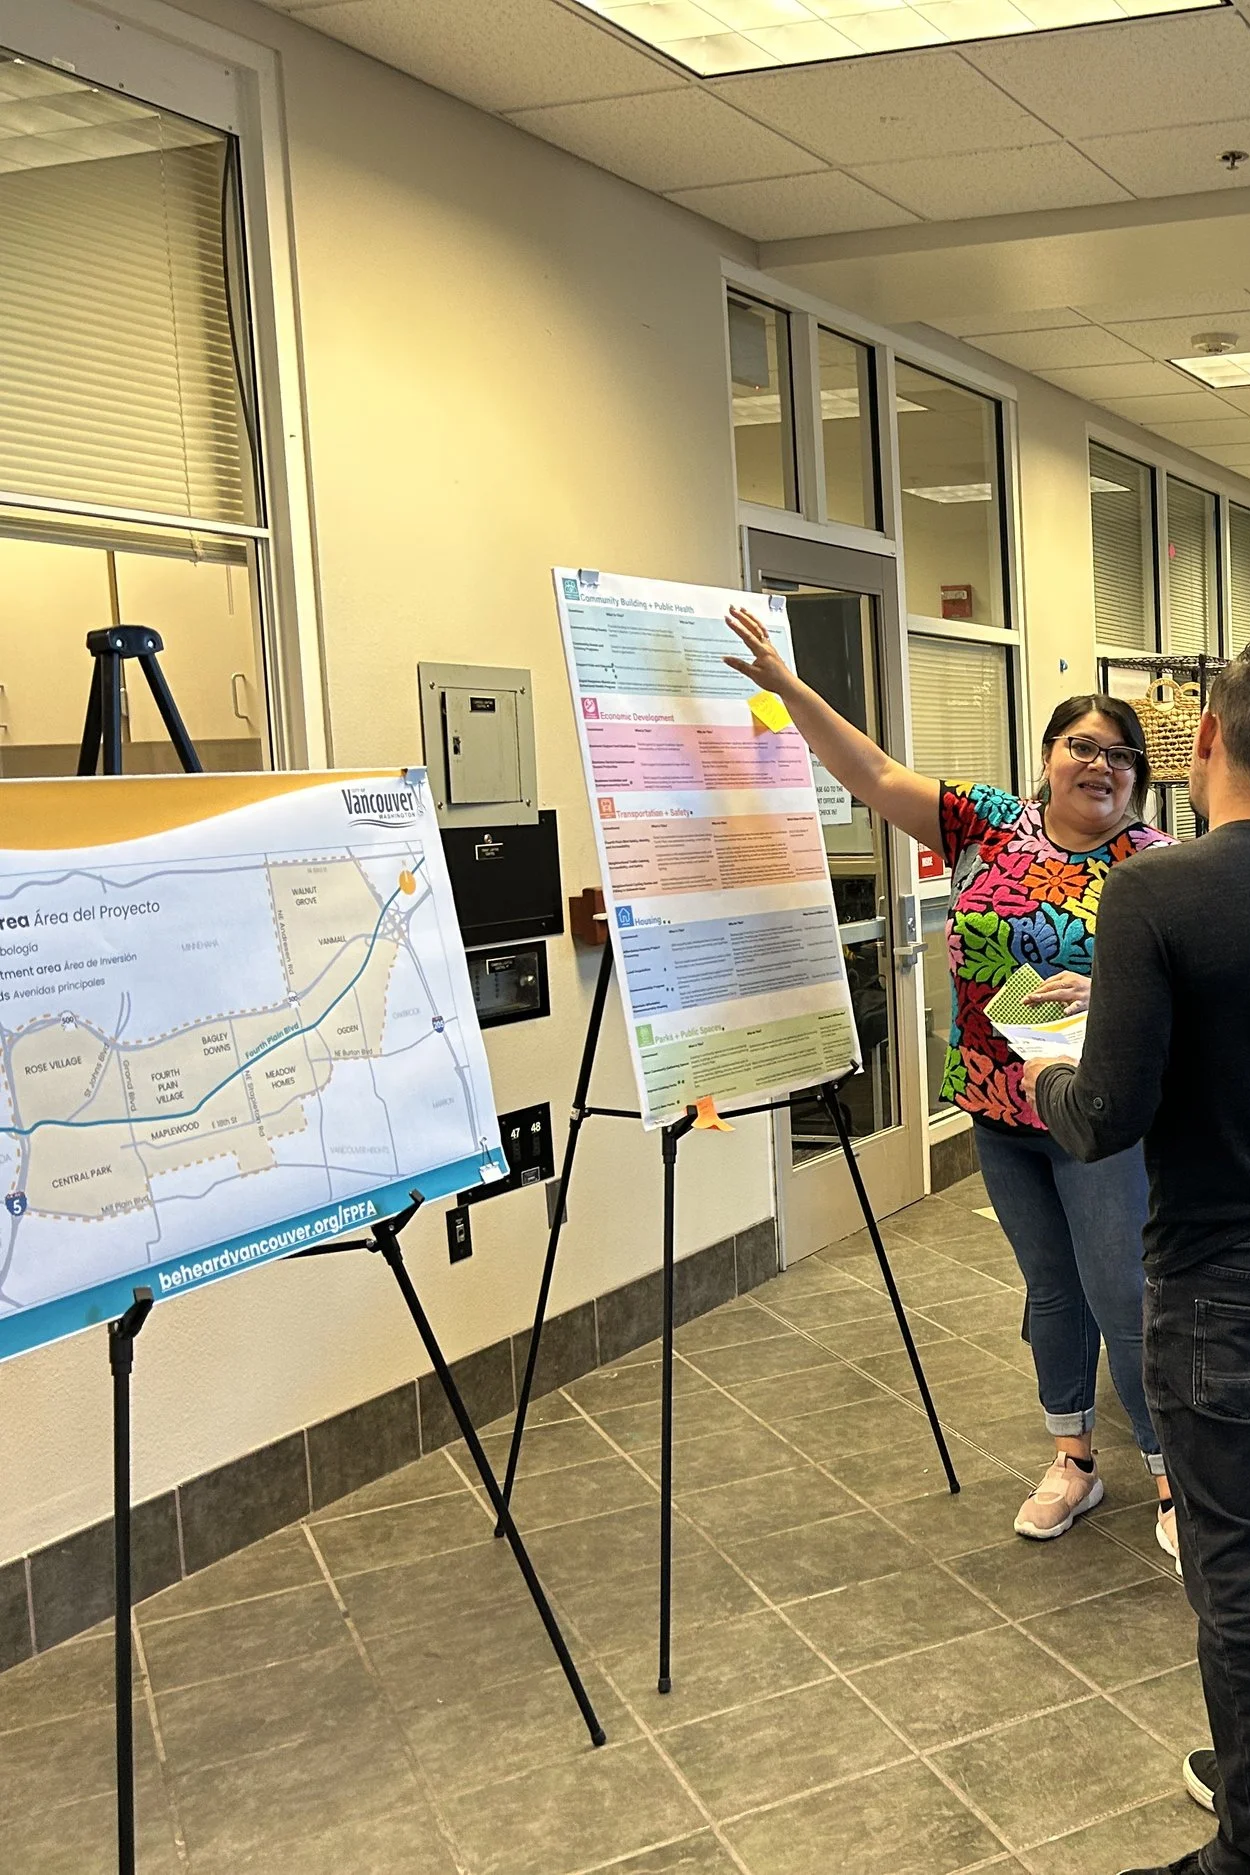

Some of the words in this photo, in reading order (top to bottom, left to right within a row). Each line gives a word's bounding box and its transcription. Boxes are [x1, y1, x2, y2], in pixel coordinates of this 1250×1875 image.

[580, 594, 619, 607] Community
[620, 598, 648, 609] Building
[654, 602, 674, 612] Public
[675, 604, 694, 613] Health
[600, 712, 631, 721] Economic
[633, 713, 674, 722] Development
[341, 789, 414, 815] Vancouver
[616, 808, 664, 818] Transportation
[670, 808, 690, 818] Safety
[291, 887, 317, 896] WALNUT
[296, 897, 317, 907] GROVE
[0, 914, 30, 930] rea
[34, 909, 69, 927] Área
[73, 906, 95, 922] del
[100, 901, 160, 920] Proyecto
[635, 917, 662, 926] Housing
[318, 936, 346, 946] VANMALL
[279, 922, 290, 963] Andresen
[288, 963, 295, 975] Rd
[0, 965, 34, 981] tment
[36, 963, 62, 976] area
[64, 960, 84, 971] Área
[86, 957, 98, 967] de
[100, 953, 137, 966] Inversión
[13, 984, 56, 1000] Avenidas
[58, 977, 106, 994] principales
[61, 1015, 74, 1024] 500
[432, 1020, 445, 1030] 205
[337, 1024, 359, 1036] OGDEN
[655, 1035, 673, 1043] Parks
[680, 1028, 698, 1039] Public
[699, 1024, 721, 1035] Spaces
[202, 1032, 228, 1045] BAGLEY
[245, 1041, 265, 1060] Fourth
[266, 1031, 285, 1045] Plain
[283, 1022, 300, 1035] Blvd
[203, 1044, 231, 1056] DOWNS
[334, 1049, 342, 1057] NE
[361, 1048, 373, 1056] Blvd
[24, 1062, 48, 1075] ROSE
[50, 1056, 82, 1070] VILLAGE
[84, 1087, 92, 1098] St
[88, 1062, 102, 1090] Johns
[99, 1042, 110, 1064] Blvd
[265, 1066, 296, 1079] MEADOW
[151, 1068, 181, 1082] FOURTH
[123, 1060, 133, 1091] Grand
[128, 1091, 137, 1112] Blvd
[158, 1080, 179, 1092] PLAIN
[271, 1077, 296, 1089] HOMES
[156, 1091, 184, 1105] VILLAGE
[244, 1070, 252, 1081] NE
[258, 1125, 265, 1137] Rd
[212, 1121, 216, 1129] E
[230, 1116, 238, 1125] St
[151, 1121, 200, 1141] MAPLEWOOD
[511, 1127, 520, 1139] 47
[531, 1121, 541, 1132] 48
[51, 1172, 90, 1189] CENTRAL
[91, 1165, 113, 1178] PARK
[13, 1200, 22, 1214] 5
[101, 1204, 114, 1214] Mill
[115, 1200, 133, 1210] Plain
[134, 1194, 149, 1207] Blvd
[159, 1199, 377, 1291] beheardvancouver.org/FPFA
